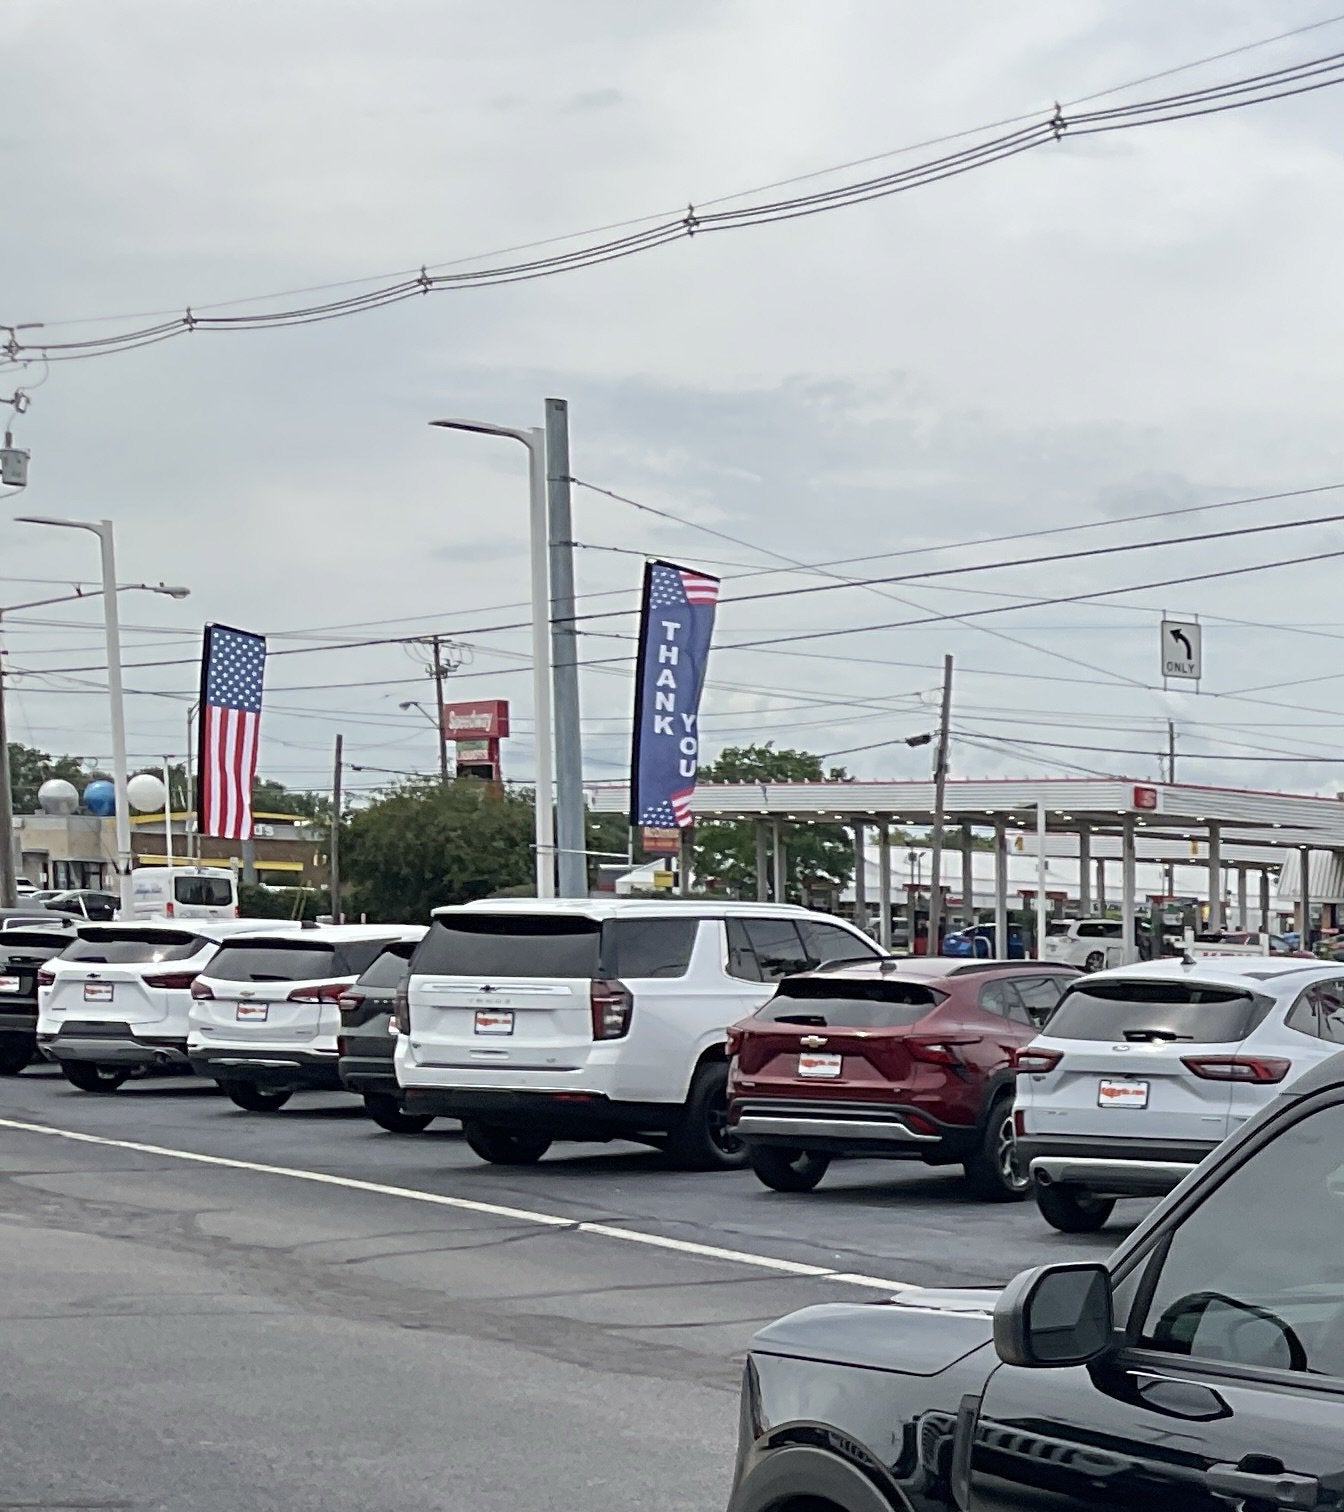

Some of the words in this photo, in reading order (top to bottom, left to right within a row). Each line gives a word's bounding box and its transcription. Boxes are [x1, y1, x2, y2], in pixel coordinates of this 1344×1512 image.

[654, 620, 681, 735] THANK
[1166, 661, 1195, 674] ONLY
[679, 712, 698, 778] YOU
